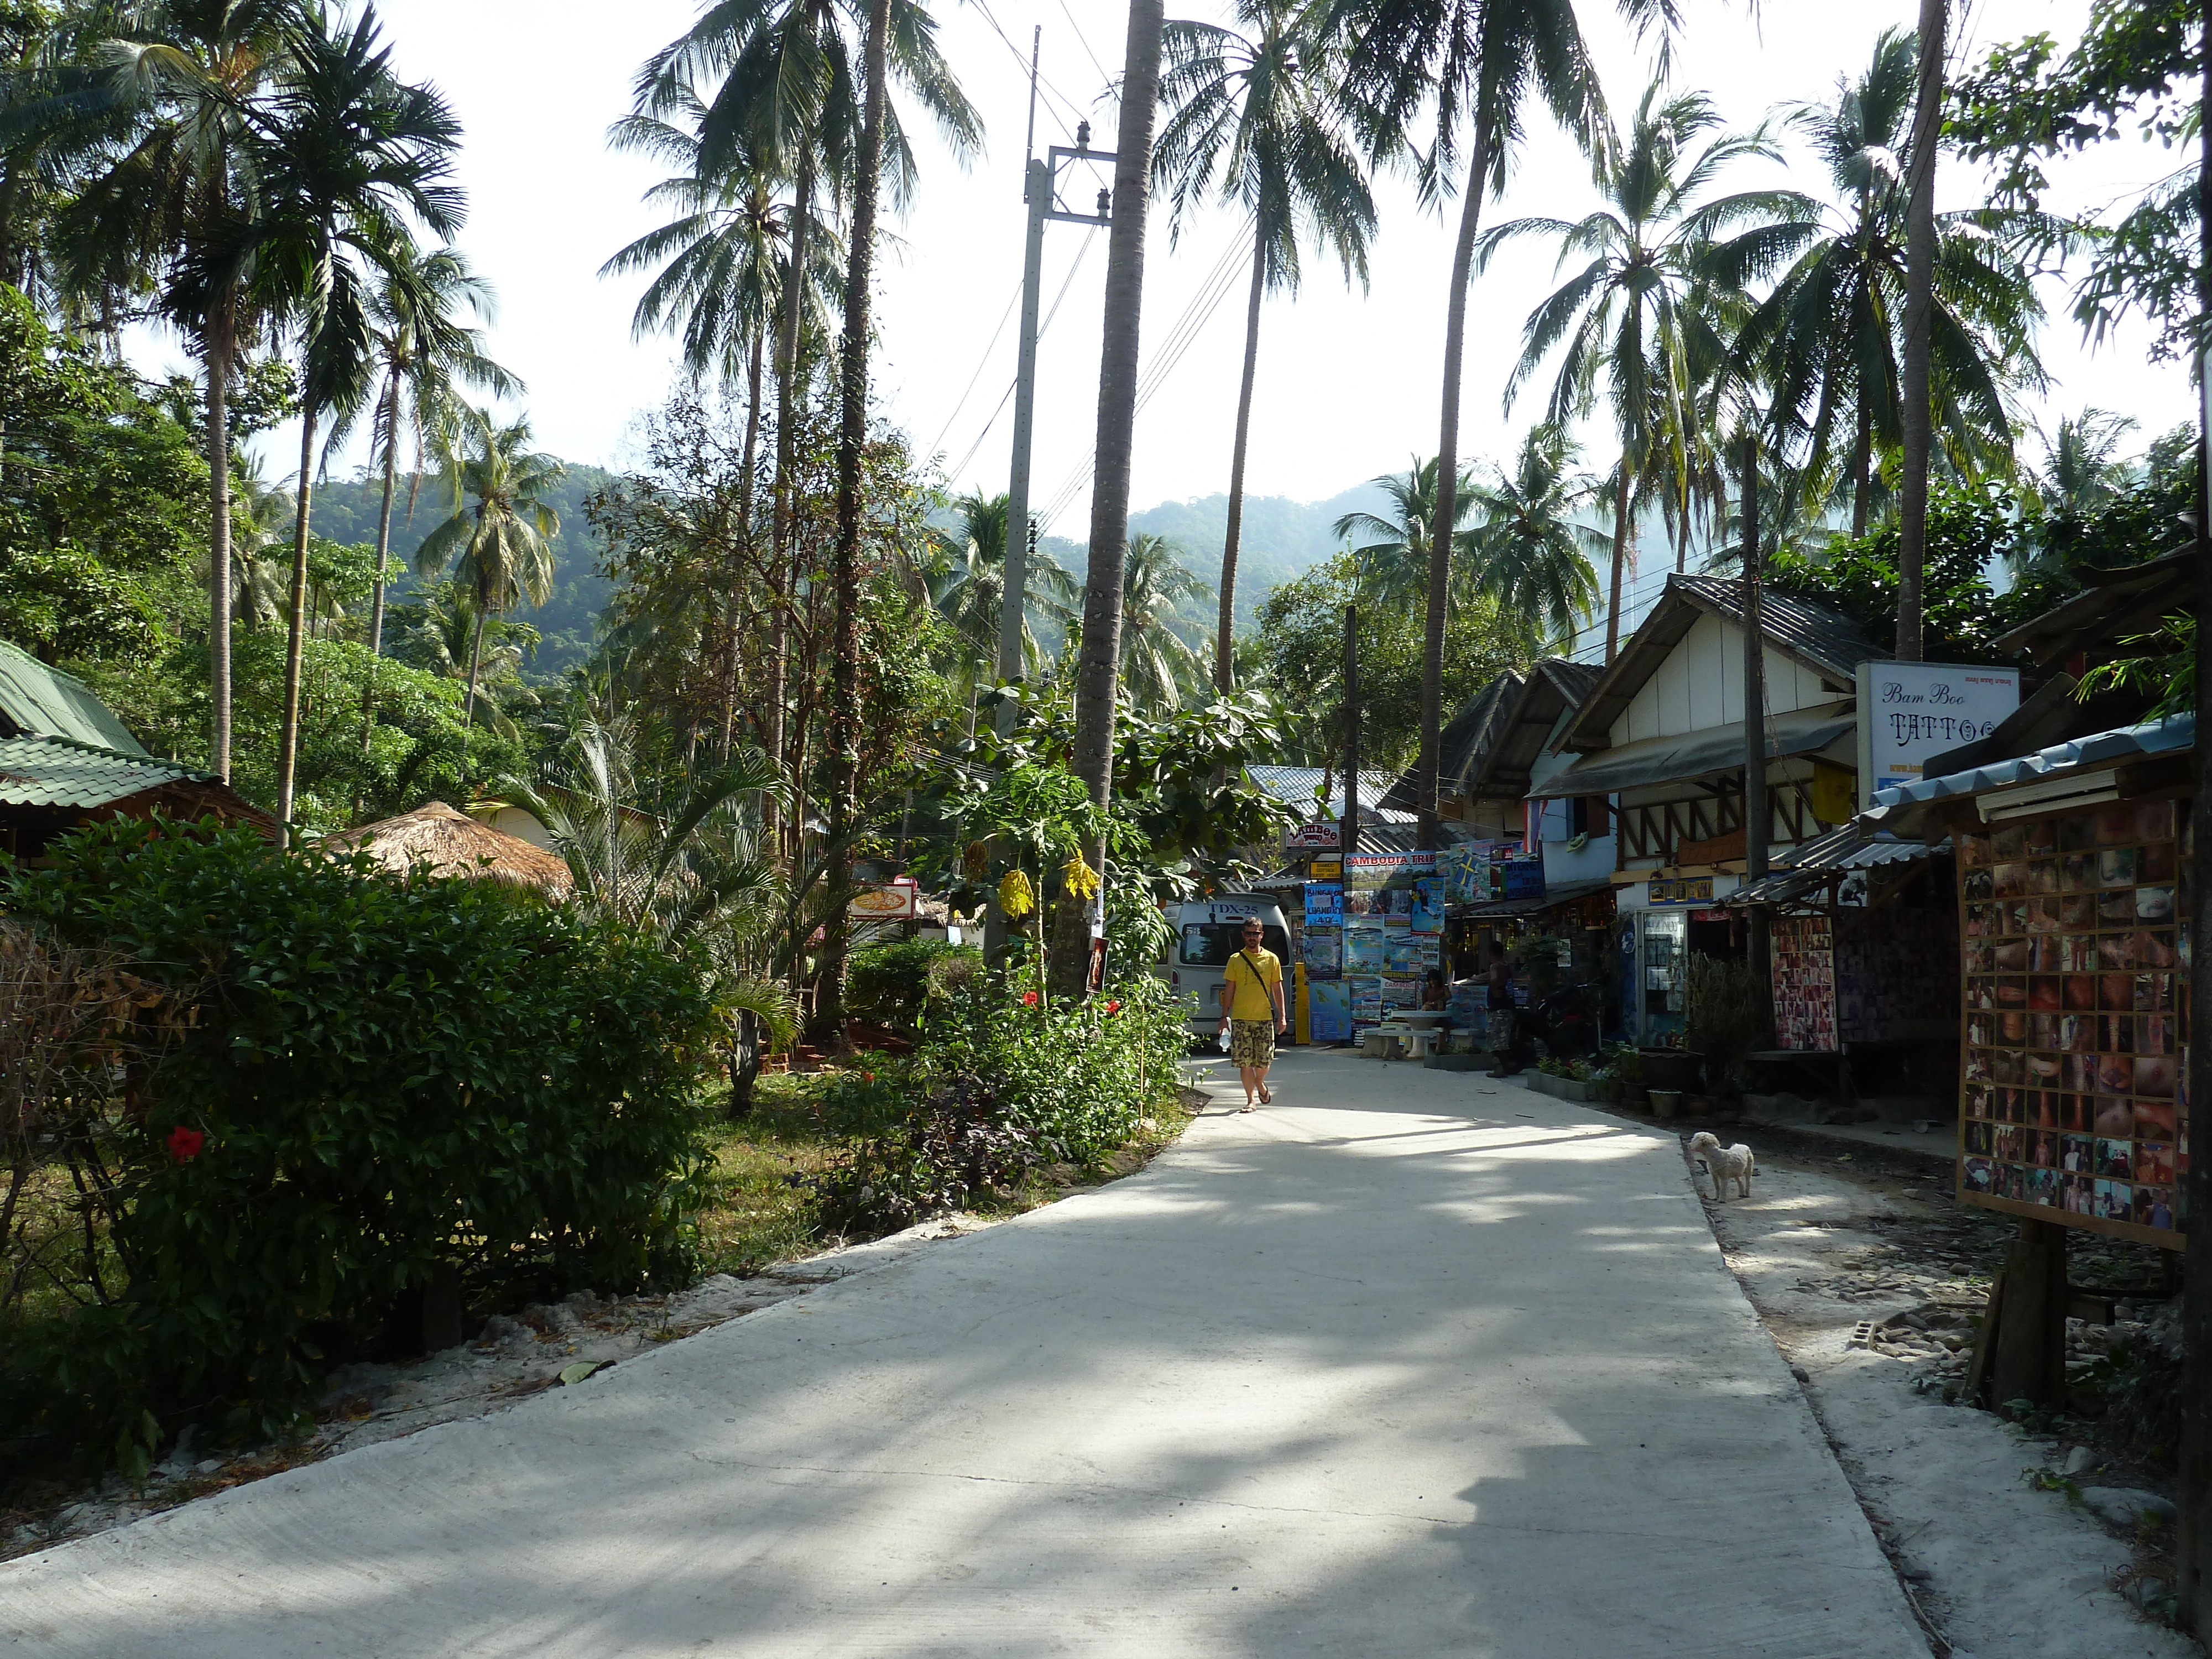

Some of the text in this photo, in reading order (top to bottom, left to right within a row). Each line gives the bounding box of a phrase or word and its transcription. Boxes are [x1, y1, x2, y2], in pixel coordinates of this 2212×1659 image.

[1882, 682, 1965, 705] Bam Boo
[1345, 854, 1435, 867] CAMBODIA TRIP
[1208, 904, 1259, 914] TDX-25
